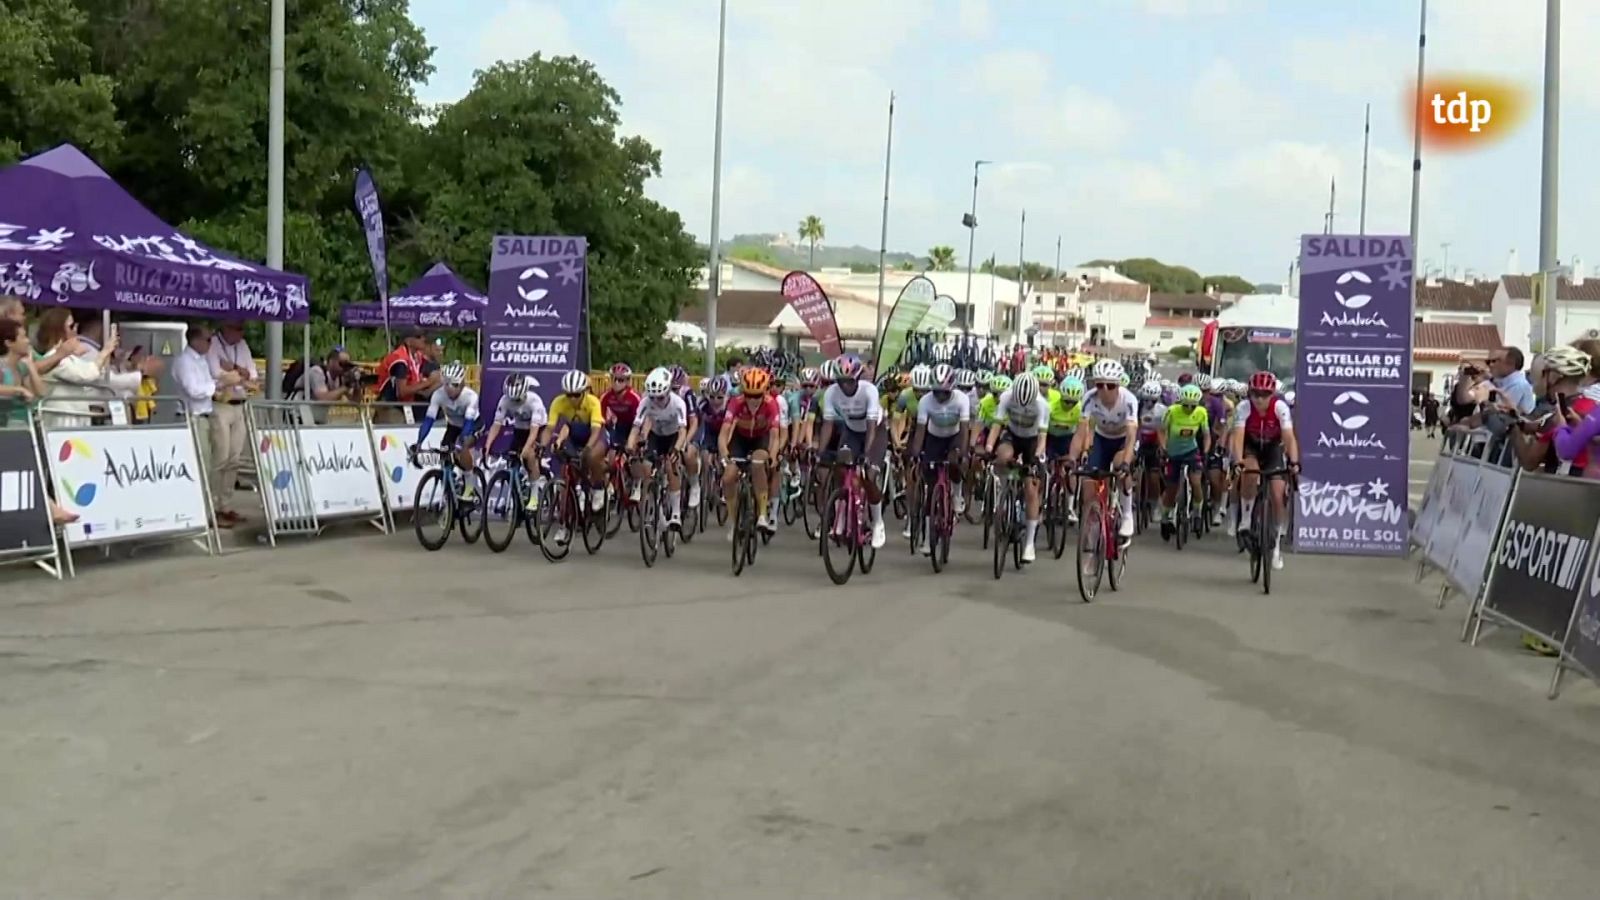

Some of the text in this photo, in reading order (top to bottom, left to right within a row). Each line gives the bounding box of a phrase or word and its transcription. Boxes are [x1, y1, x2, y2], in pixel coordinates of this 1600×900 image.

[497, 239, 578, 255] SALIDA
[1307, 238, 1406, 257] SALIDA
[115, 263, 230, 294] RUTA DEL SOL
[115, 291, 143, 303] VUELTA
[145, 294, 180, 306] CICLISTA
[1320, 311, 1389, 328] Andalucía
[490, 342, 569, 353] CASTELLAR DE
[490, 353, 567, 363] LA FRONTERA
[1306, 353, 1402, 366] CASTELLAR DE
[1307, 366, 1400, 379] LA FRONTERA
[1317, 431, 1386, 449] Andalucía
[103, 444, 195, 489] Andalucía
[1299, 481, 1365, 497] ELITE
[1299, 495, 1402, 525] WOMEN
[1299, 527, 1403, 542] RUTA DEL SOL
[1500, 519, 1570, 585] GSPORT
